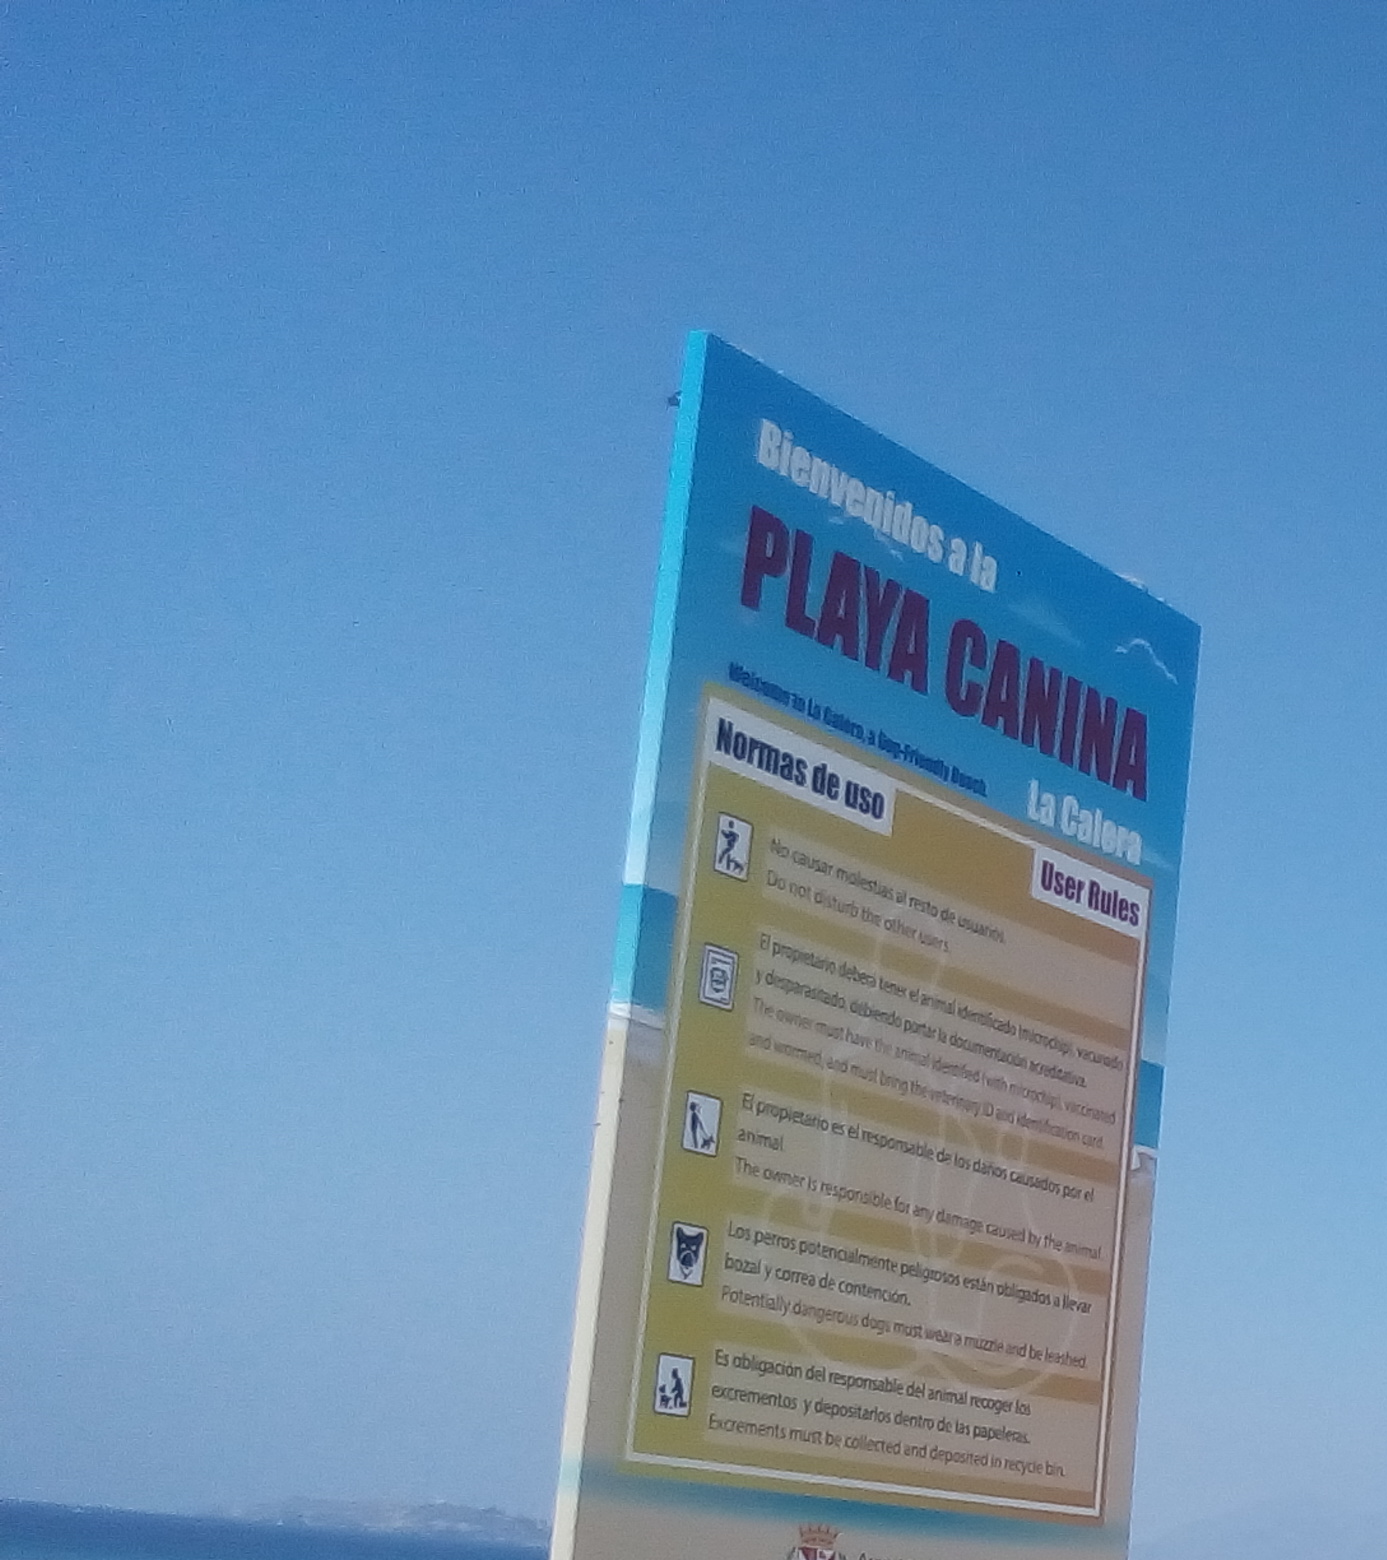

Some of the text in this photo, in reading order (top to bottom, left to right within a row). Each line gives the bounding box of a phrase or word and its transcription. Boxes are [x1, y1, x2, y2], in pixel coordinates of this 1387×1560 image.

[757, 416, 998, 594] Bienvenidos a la
[740, 503, 1150, 803] PLAYA CANINA
[716, 718, 885, 819] Normas de uso
[1026, 778, 1142, 865] La Calera
[766, 870, 787, 893] Do
[789, 883, 811, 901] not
[814, 887, 858, 919] disturb
[860, 904, 882, 929] the
[884, 918, 916, 940] other
[769, 836, 789, 860] No
[791, 848, 832, 877] causar
[836, 866, 893, 900] molestias
[895, 889, 907, 906] al
[909, 897, 938, 918] resto
[939, 904, 956, 925] de
[1040, 860, 1140, 926] User Rules
[752, 995, 775, 1018] The
[776, 1008, 810, 1029] owner
[815, 1020, 842, 1040] must
[846, 1027, 873, 1050] have
[874, 1035, 893, 1056] the
[895, 1045, 930, 1068] animal
[755, 967, 763, 986] y
[849, 996, 901, 1030] debiendo
[903, 1020, 935, 1039] portar
[936, 1027, 947, 1044] la
[759, 933, 771, 952] El
[772, 942, 834, 974] propietario
[879, 977, 906, 999] tener
[908, 986, 919, 1004] el
[920, 992, 955, 1016] animal
[957, 1002, 1016, 1037] identificado
[1076, 1047, 1122, 1073] vacunado
[749, 1033, 771, 1050] and
[826, 1056, 848, 1075] and
[850, 1065, 877, 1083] must
[880, 1070, 908, 1096] bring
[909, 1078, 927, 1099] the
[995, 1107, 1015, 1125] and
[741, 1091, 1094, 1203] El propietario es el responsable de los daños causados por el
[734, 1156, 759, 1178] The
[763, 1167, 804, 1189] owner
[807, 1175, 818, 1192] is
[820, 1181, 890, 1210] responsible
[893, 1194, 910, 1215] for
[911, 1202, 934, 1224] any
[935, 1206, 982, 1234] damage
[986, 1221, 1025, 1242] caused
[1027, 1228, 1042, 1249] by
[1043, 1232, 1062, 1251] the
[724, 1252, 910, 1306] bozal y correa de contención.
[728, 1221, 1092, 1314] Los perros potencialmente peligrosos están obligados a llevar
[722, 1284, 790, 1316] Potentially
[793, 1299, 858, 1326] dangerous
[862, 1312, 890, 1333] dogs
[893, 1322, 922, 1338] must
[926, 1328, 950, 1343] wear
[953, 1332, 963, 1347] a
[964, 1335, 1002, 1353] muzzle
[1004, 1342, 1027, 1358] and
[1028, 1344, 1043, 1361] be
[711, 1386, 1030, 1443] excrementos y depositarlos dentro de las papeleras.
[713, 1348, 1032, 1416] Es obligación del responsable del animal recoger los
[709, 1414, 1066, 1478] Excrements must be collected and deposited in recycle bin.
